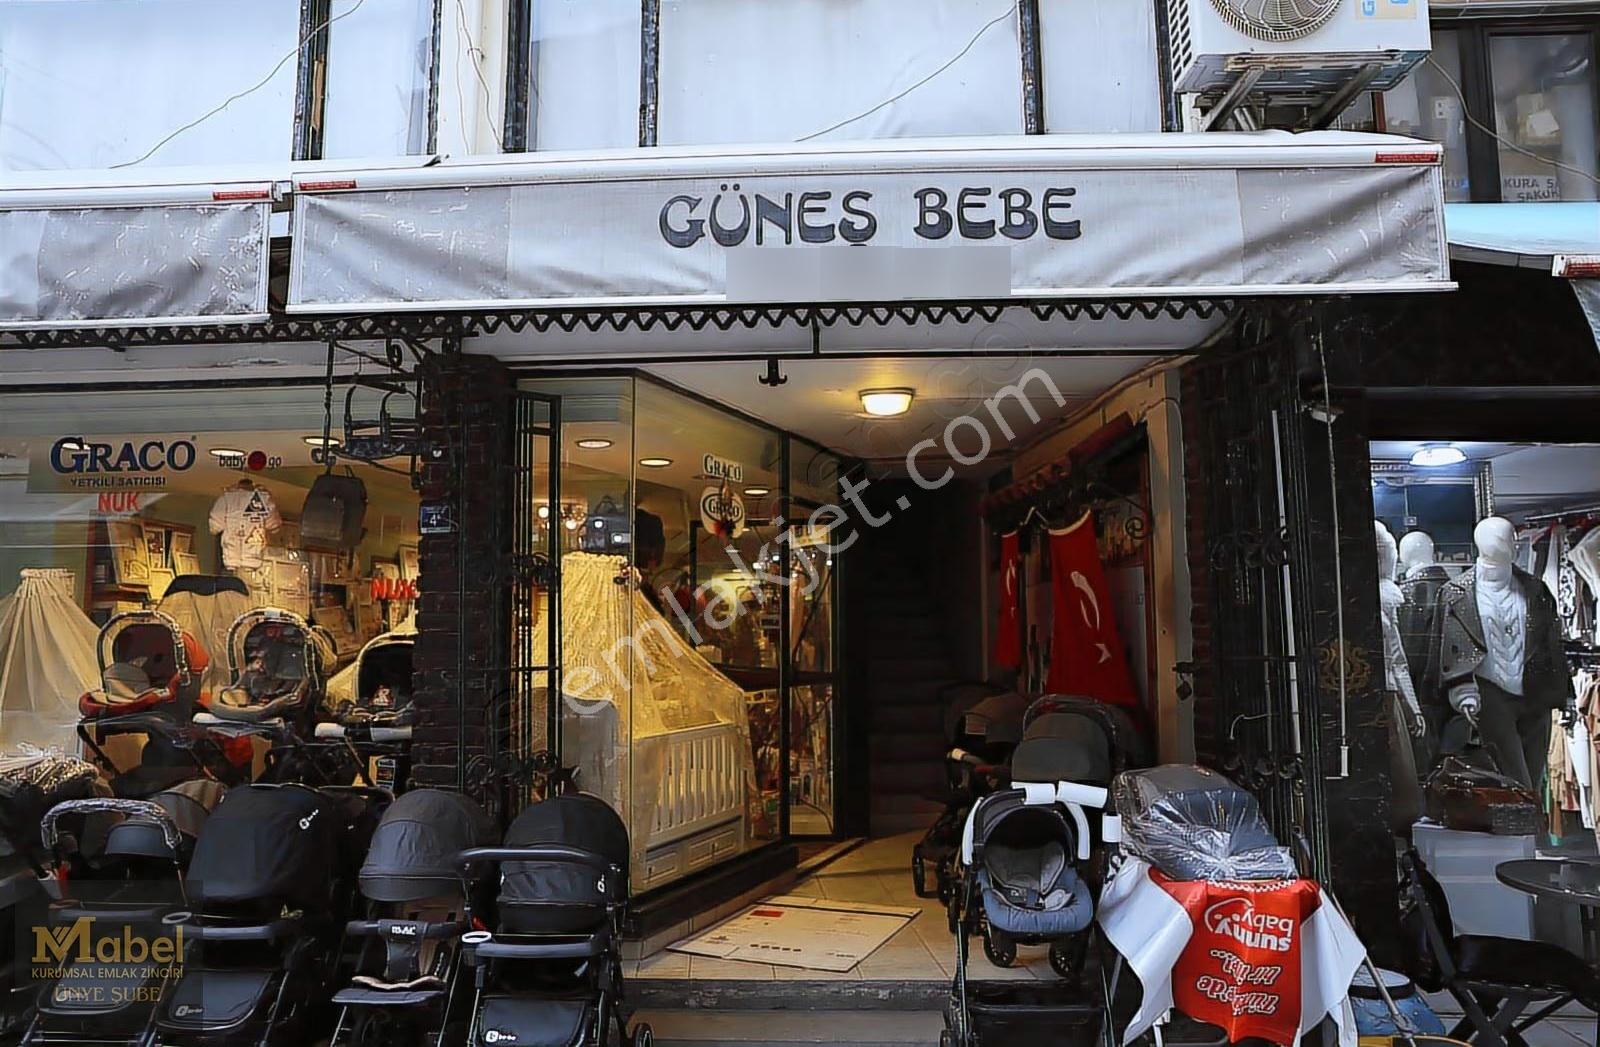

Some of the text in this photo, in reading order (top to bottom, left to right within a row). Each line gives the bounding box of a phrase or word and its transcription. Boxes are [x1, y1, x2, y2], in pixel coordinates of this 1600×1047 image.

[913, 186, 1082, 241] BEBE
[50, 436, 197, 474] GRACO
[703, 454, 742, 481] GRACO
[98, 491, 141, 512] NUK
[1214, 917, 1293, 952] sunny
[1241, 907, 1294, 938] baby
